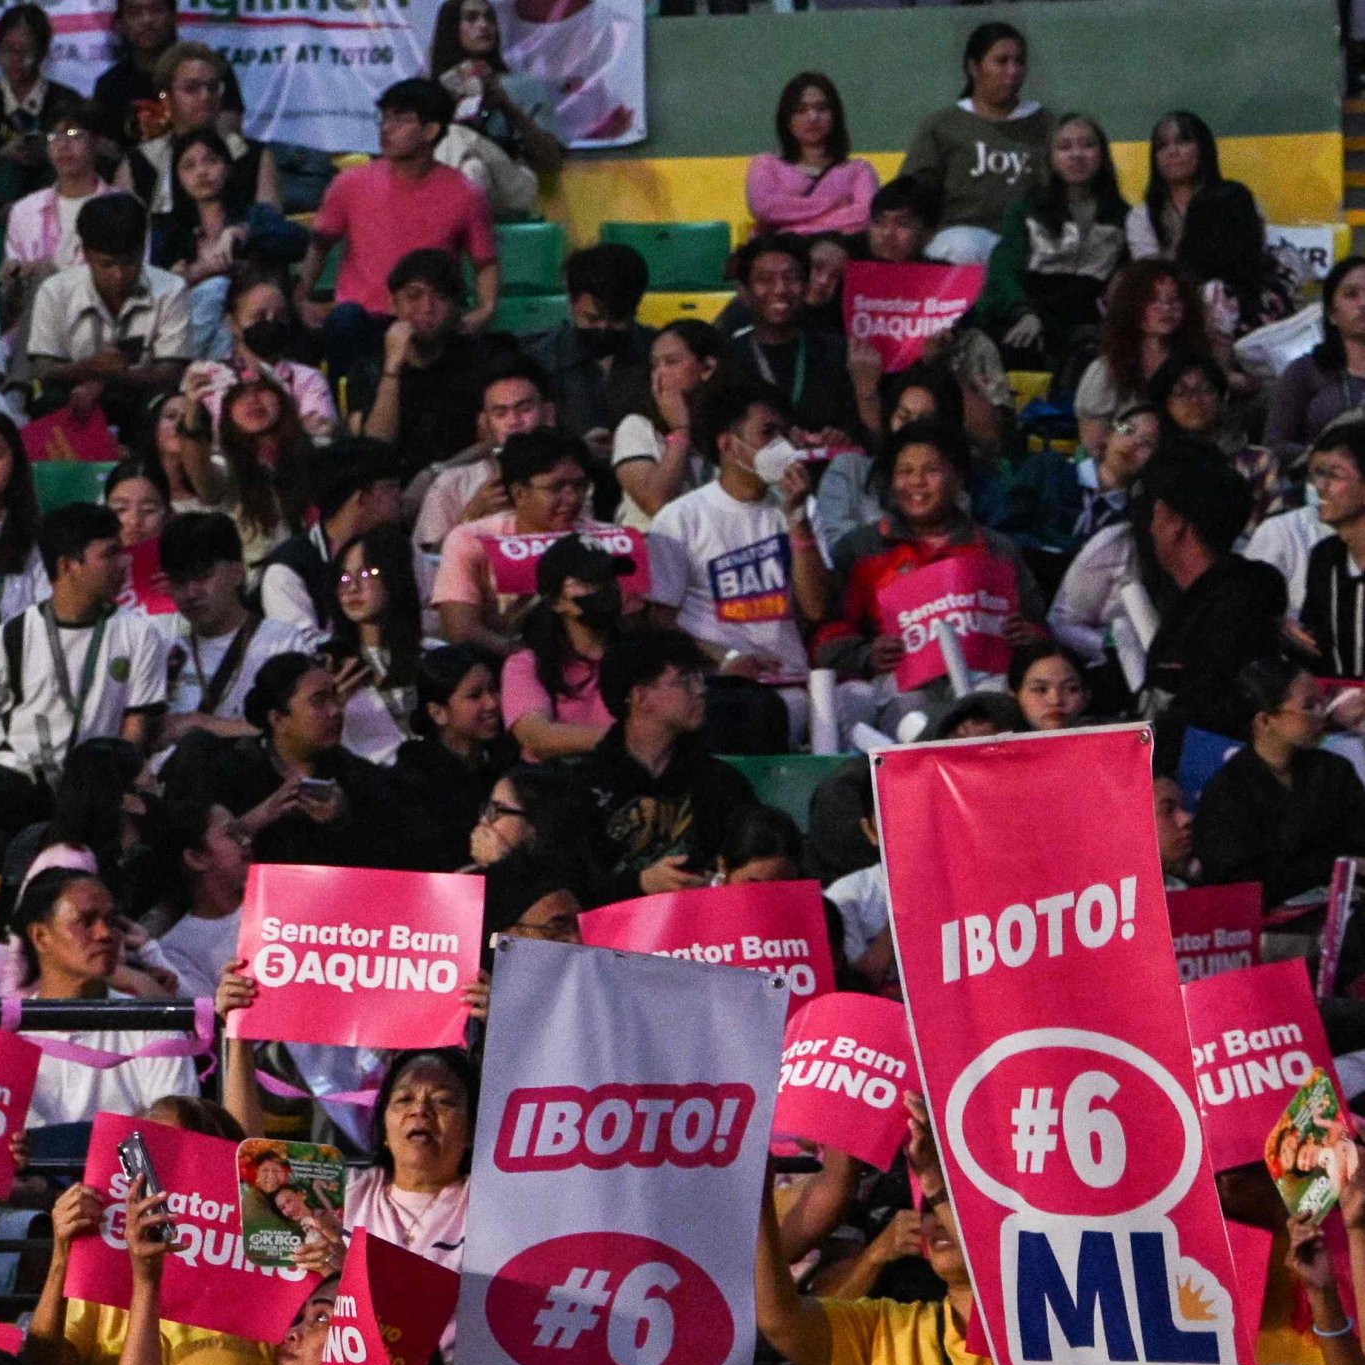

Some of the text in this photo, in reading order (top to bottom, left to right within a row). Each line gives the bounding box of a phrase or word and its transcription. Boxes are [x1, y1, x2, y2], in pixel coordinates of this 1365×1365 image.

[971, 141, 1030, 182] Joy.
[261, 917, 460, 954] Senator Bam
[742, 936, 810, 959] Bam
[940, 876, 1138, 984] IBOTO!
[296, 954, 459, 994] AQUINO
[831, 1036, 907, 1077] Bam
[1222, 1023, 1303, 1058] Bam
[509, 1098, 742, 1159] IBOTO!
[1010, 1071, 1128, 1190] #6
[1016, 1230, 1220, 1365] ML
